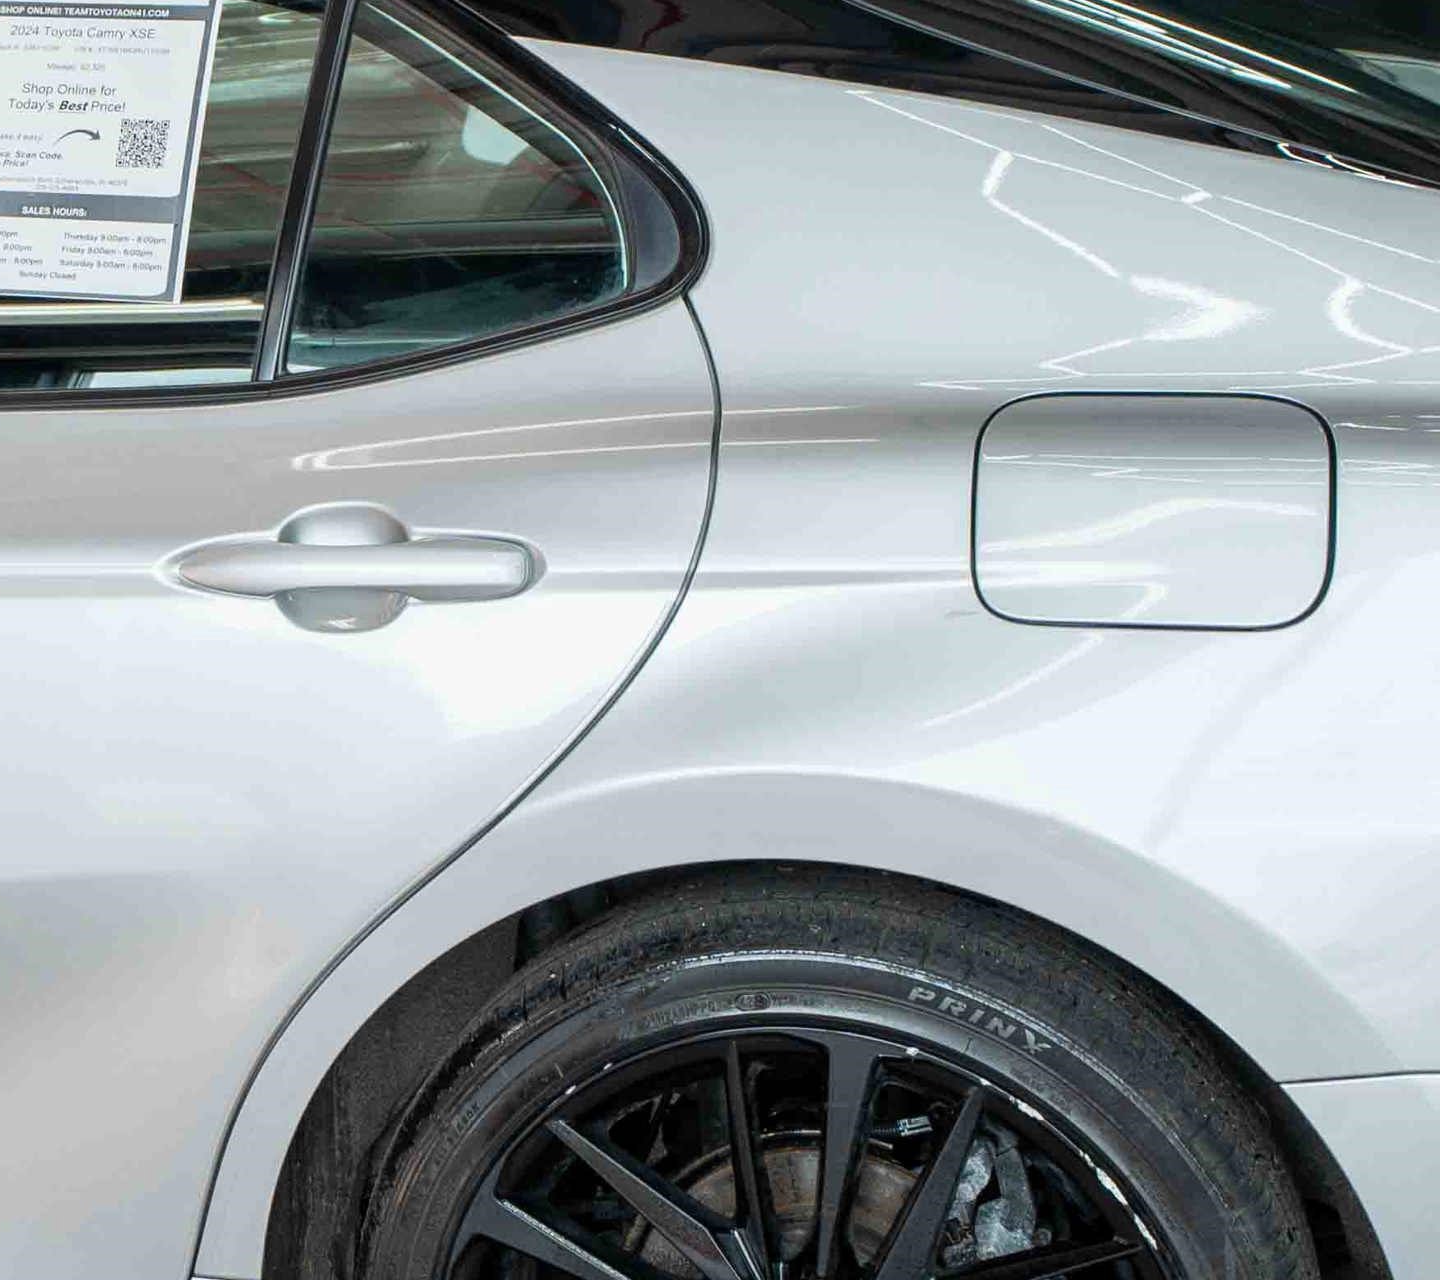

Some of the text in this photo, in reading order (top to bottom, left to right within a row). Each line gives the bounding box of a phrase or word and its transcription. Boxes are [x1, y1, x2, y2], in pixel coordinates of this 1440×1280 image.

[0, 6, 25, 14] SHOP
[10, 25, 156, 40] 2024 Toyota Camry XSE
[22, 83, 118, 96] Shop Online for
[8, 98, 126, 113] Today's Best Price!
[15, 150, 37, 159] Scan
[22, 206, 87, 217] SALES HOURS:
[906, 986, 1052, 1056] PRINX
